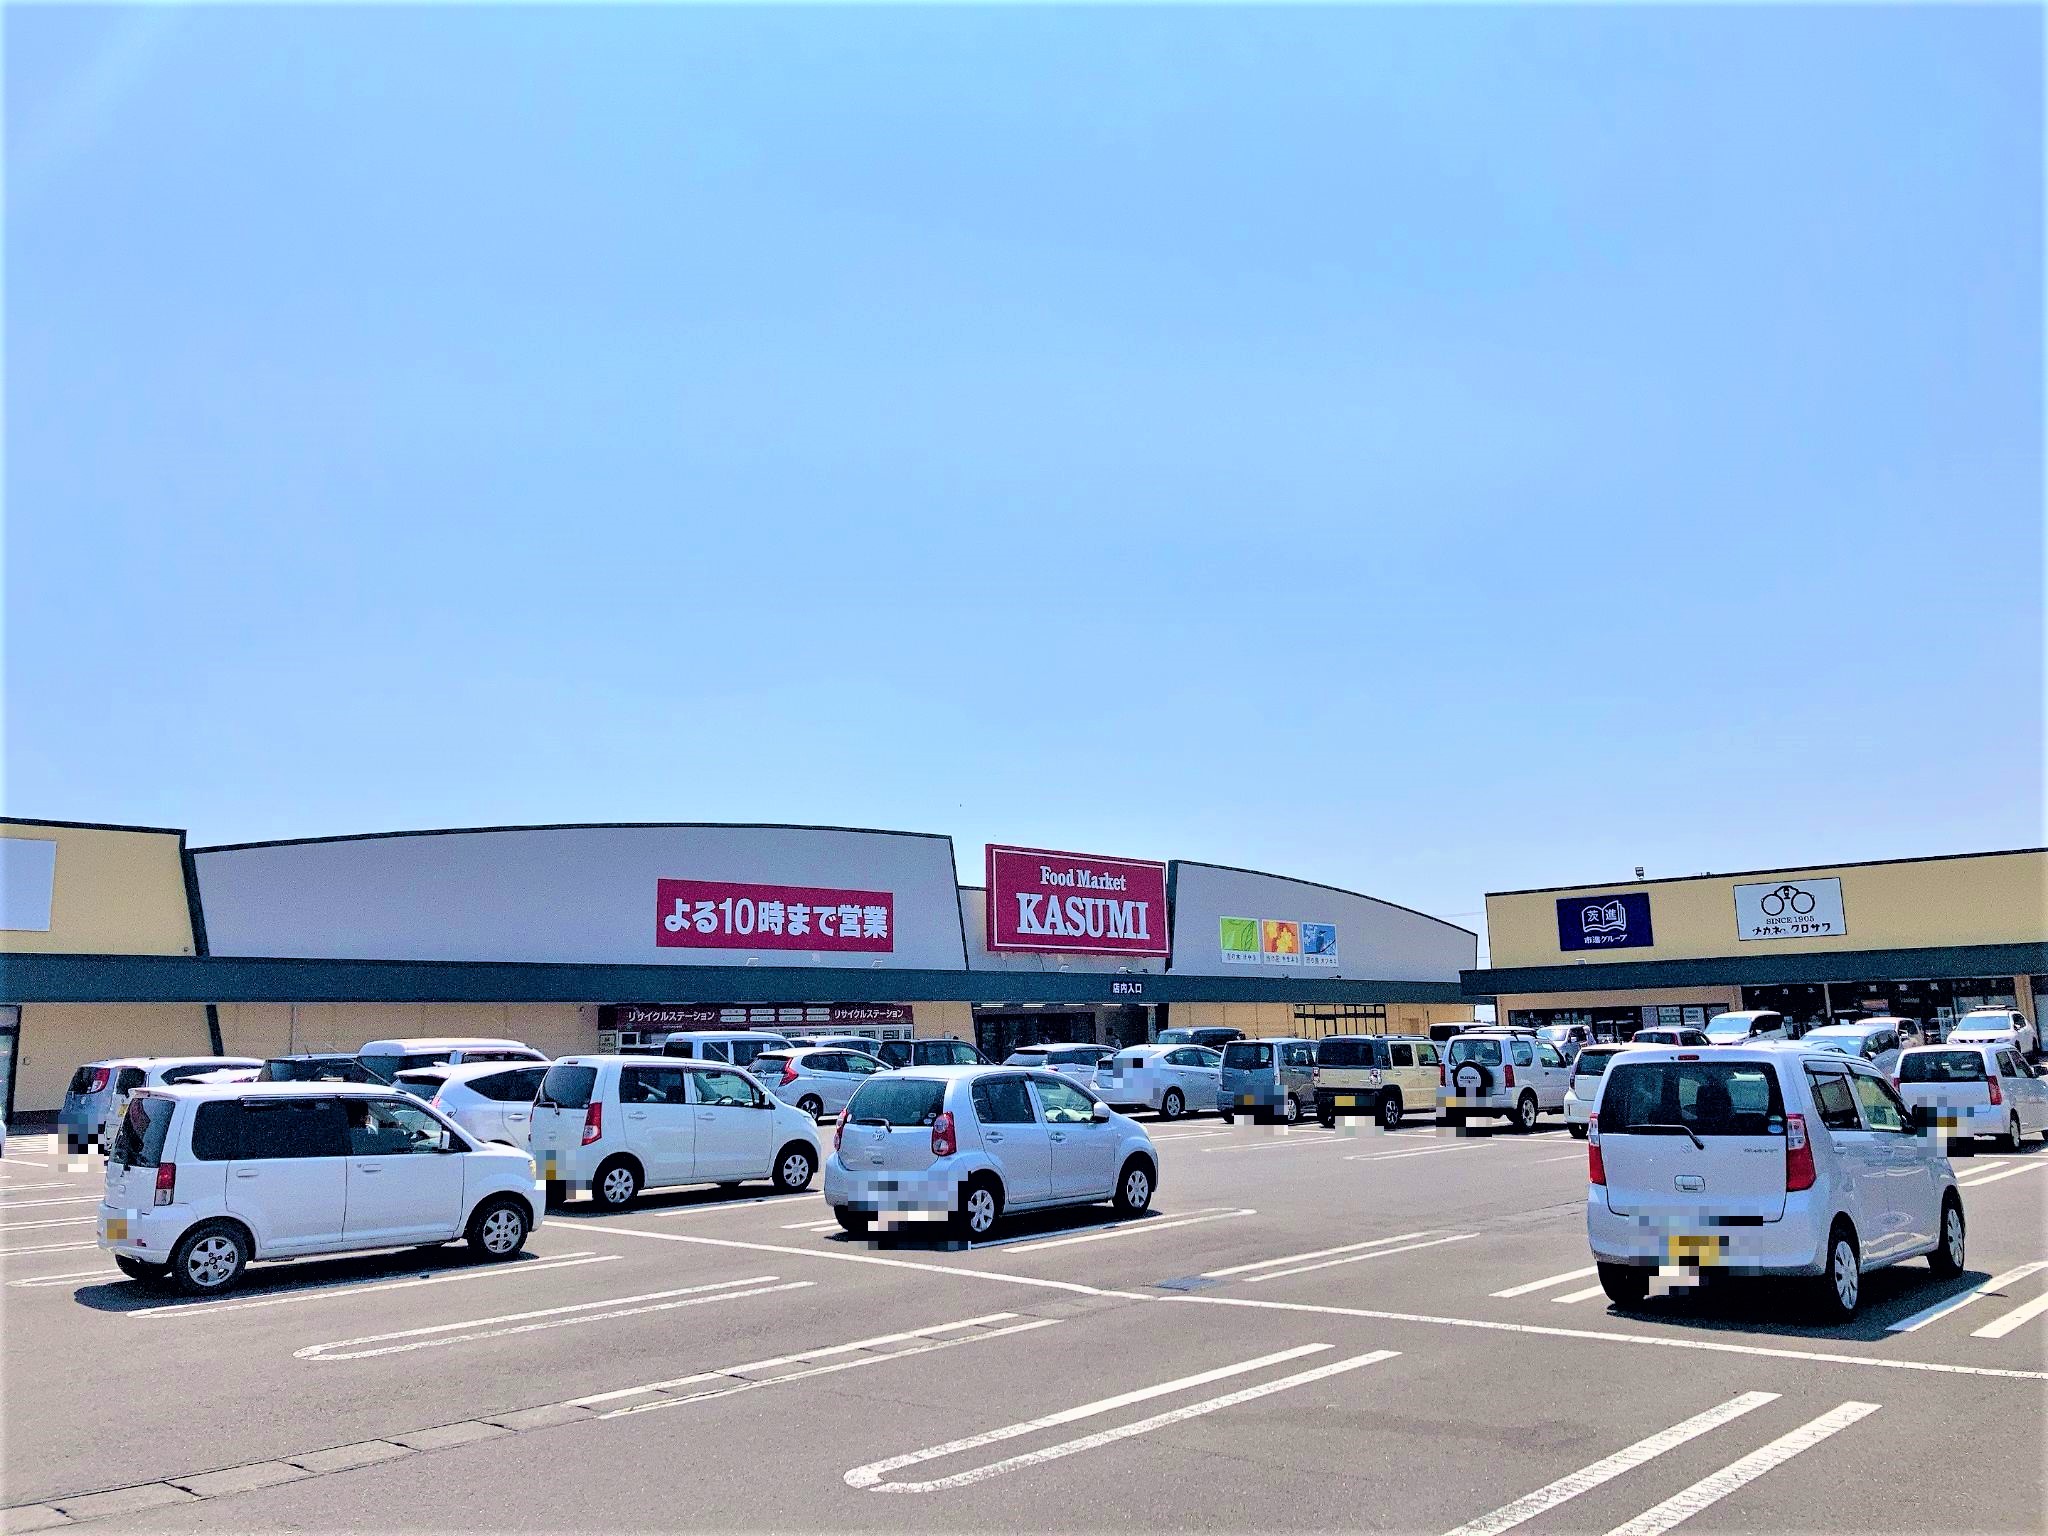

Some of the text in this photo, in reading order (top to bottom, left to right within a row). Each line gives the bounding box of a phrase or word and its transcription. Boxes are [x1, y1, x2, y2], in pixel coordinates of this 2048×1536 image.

[1040, 865, 1127, 891] Food Market
[664, 897, 888, 939] よる10時まで営業
[1015, 892, 1151, 940] KASUMI
[1766, 917, 1793, 925] SINCE
[1584, 934, 1628, 945] 市進グループ
[1112, 982, 1142, 994] 店内入口
[628, 1011, 715, 1022] リサイクルステーション
[834, 1008, 904, 1019] リサイクルステーション
